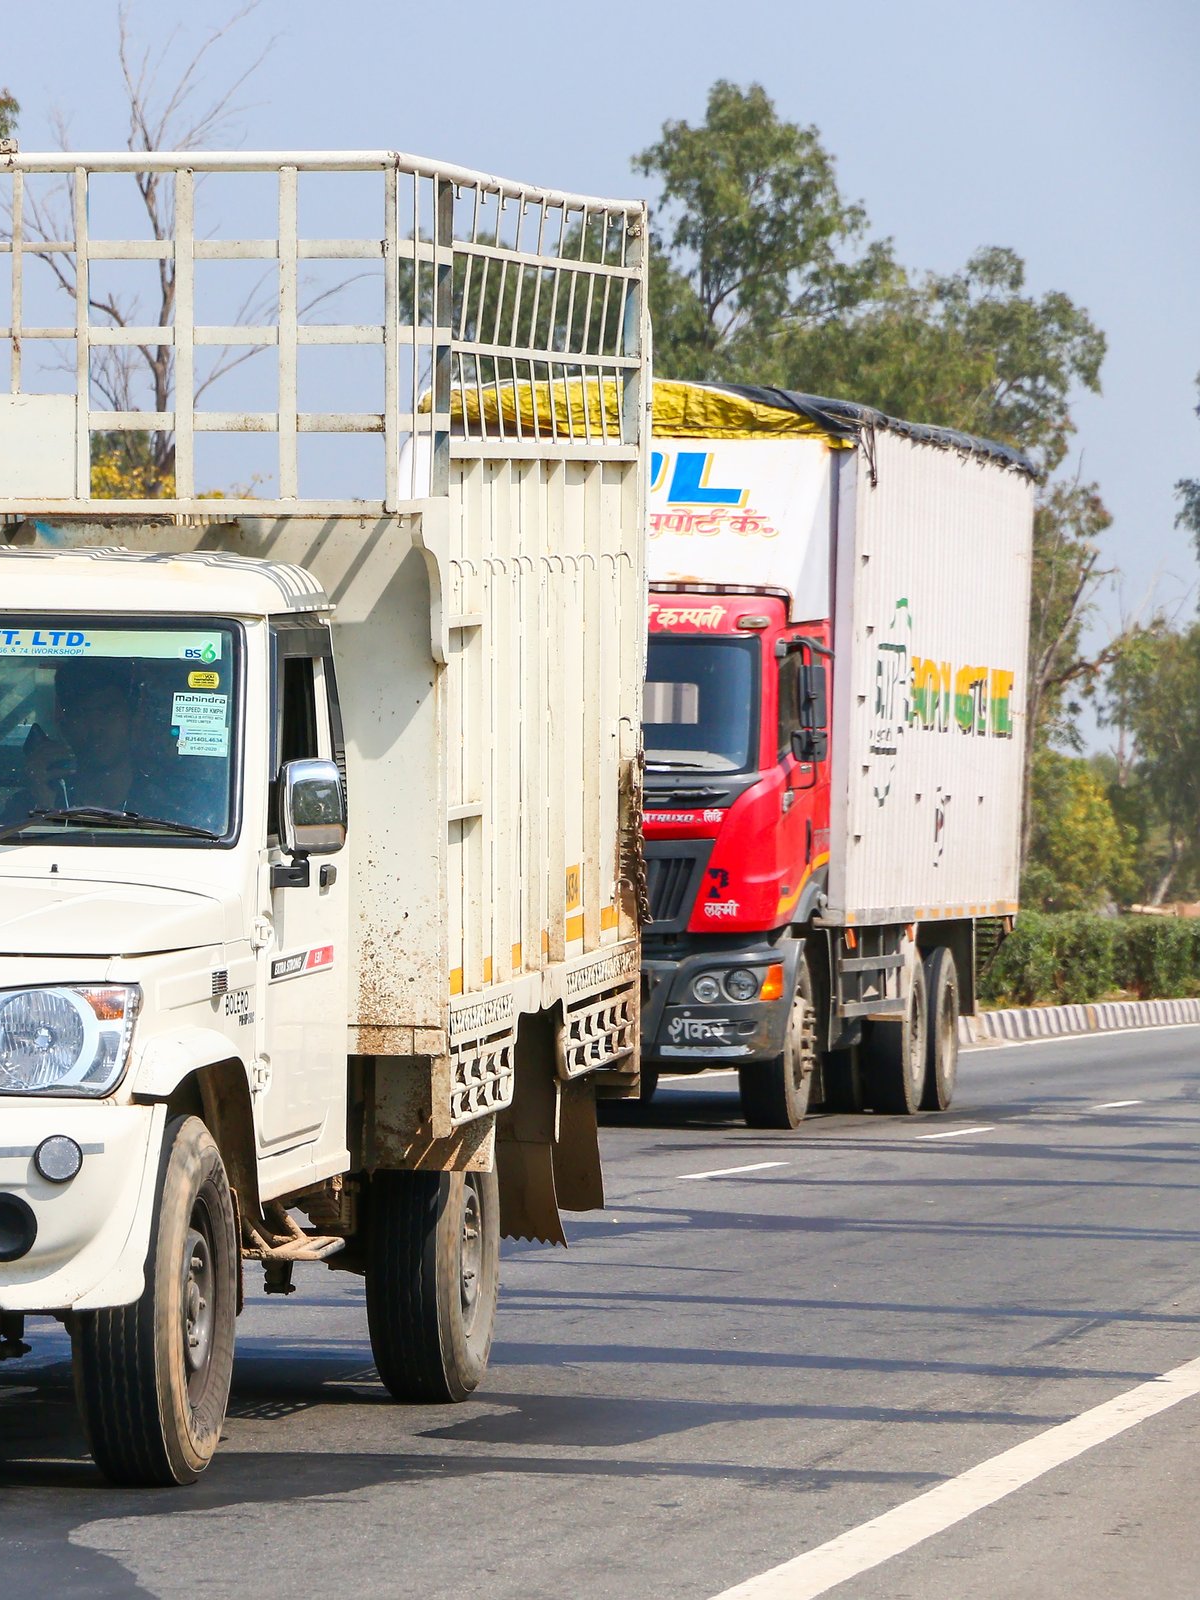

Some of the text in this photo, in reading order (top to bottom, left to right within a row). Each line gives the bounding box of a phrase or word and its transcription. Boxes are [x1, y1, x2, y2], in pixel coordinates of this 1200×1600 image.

[651, 452, 749, 507] L
[32, 631, 92, 647] LTD.
[31, 648, 85, 656] (WORKSHOP)
[225, 990, 249, 1016] BOLERO
